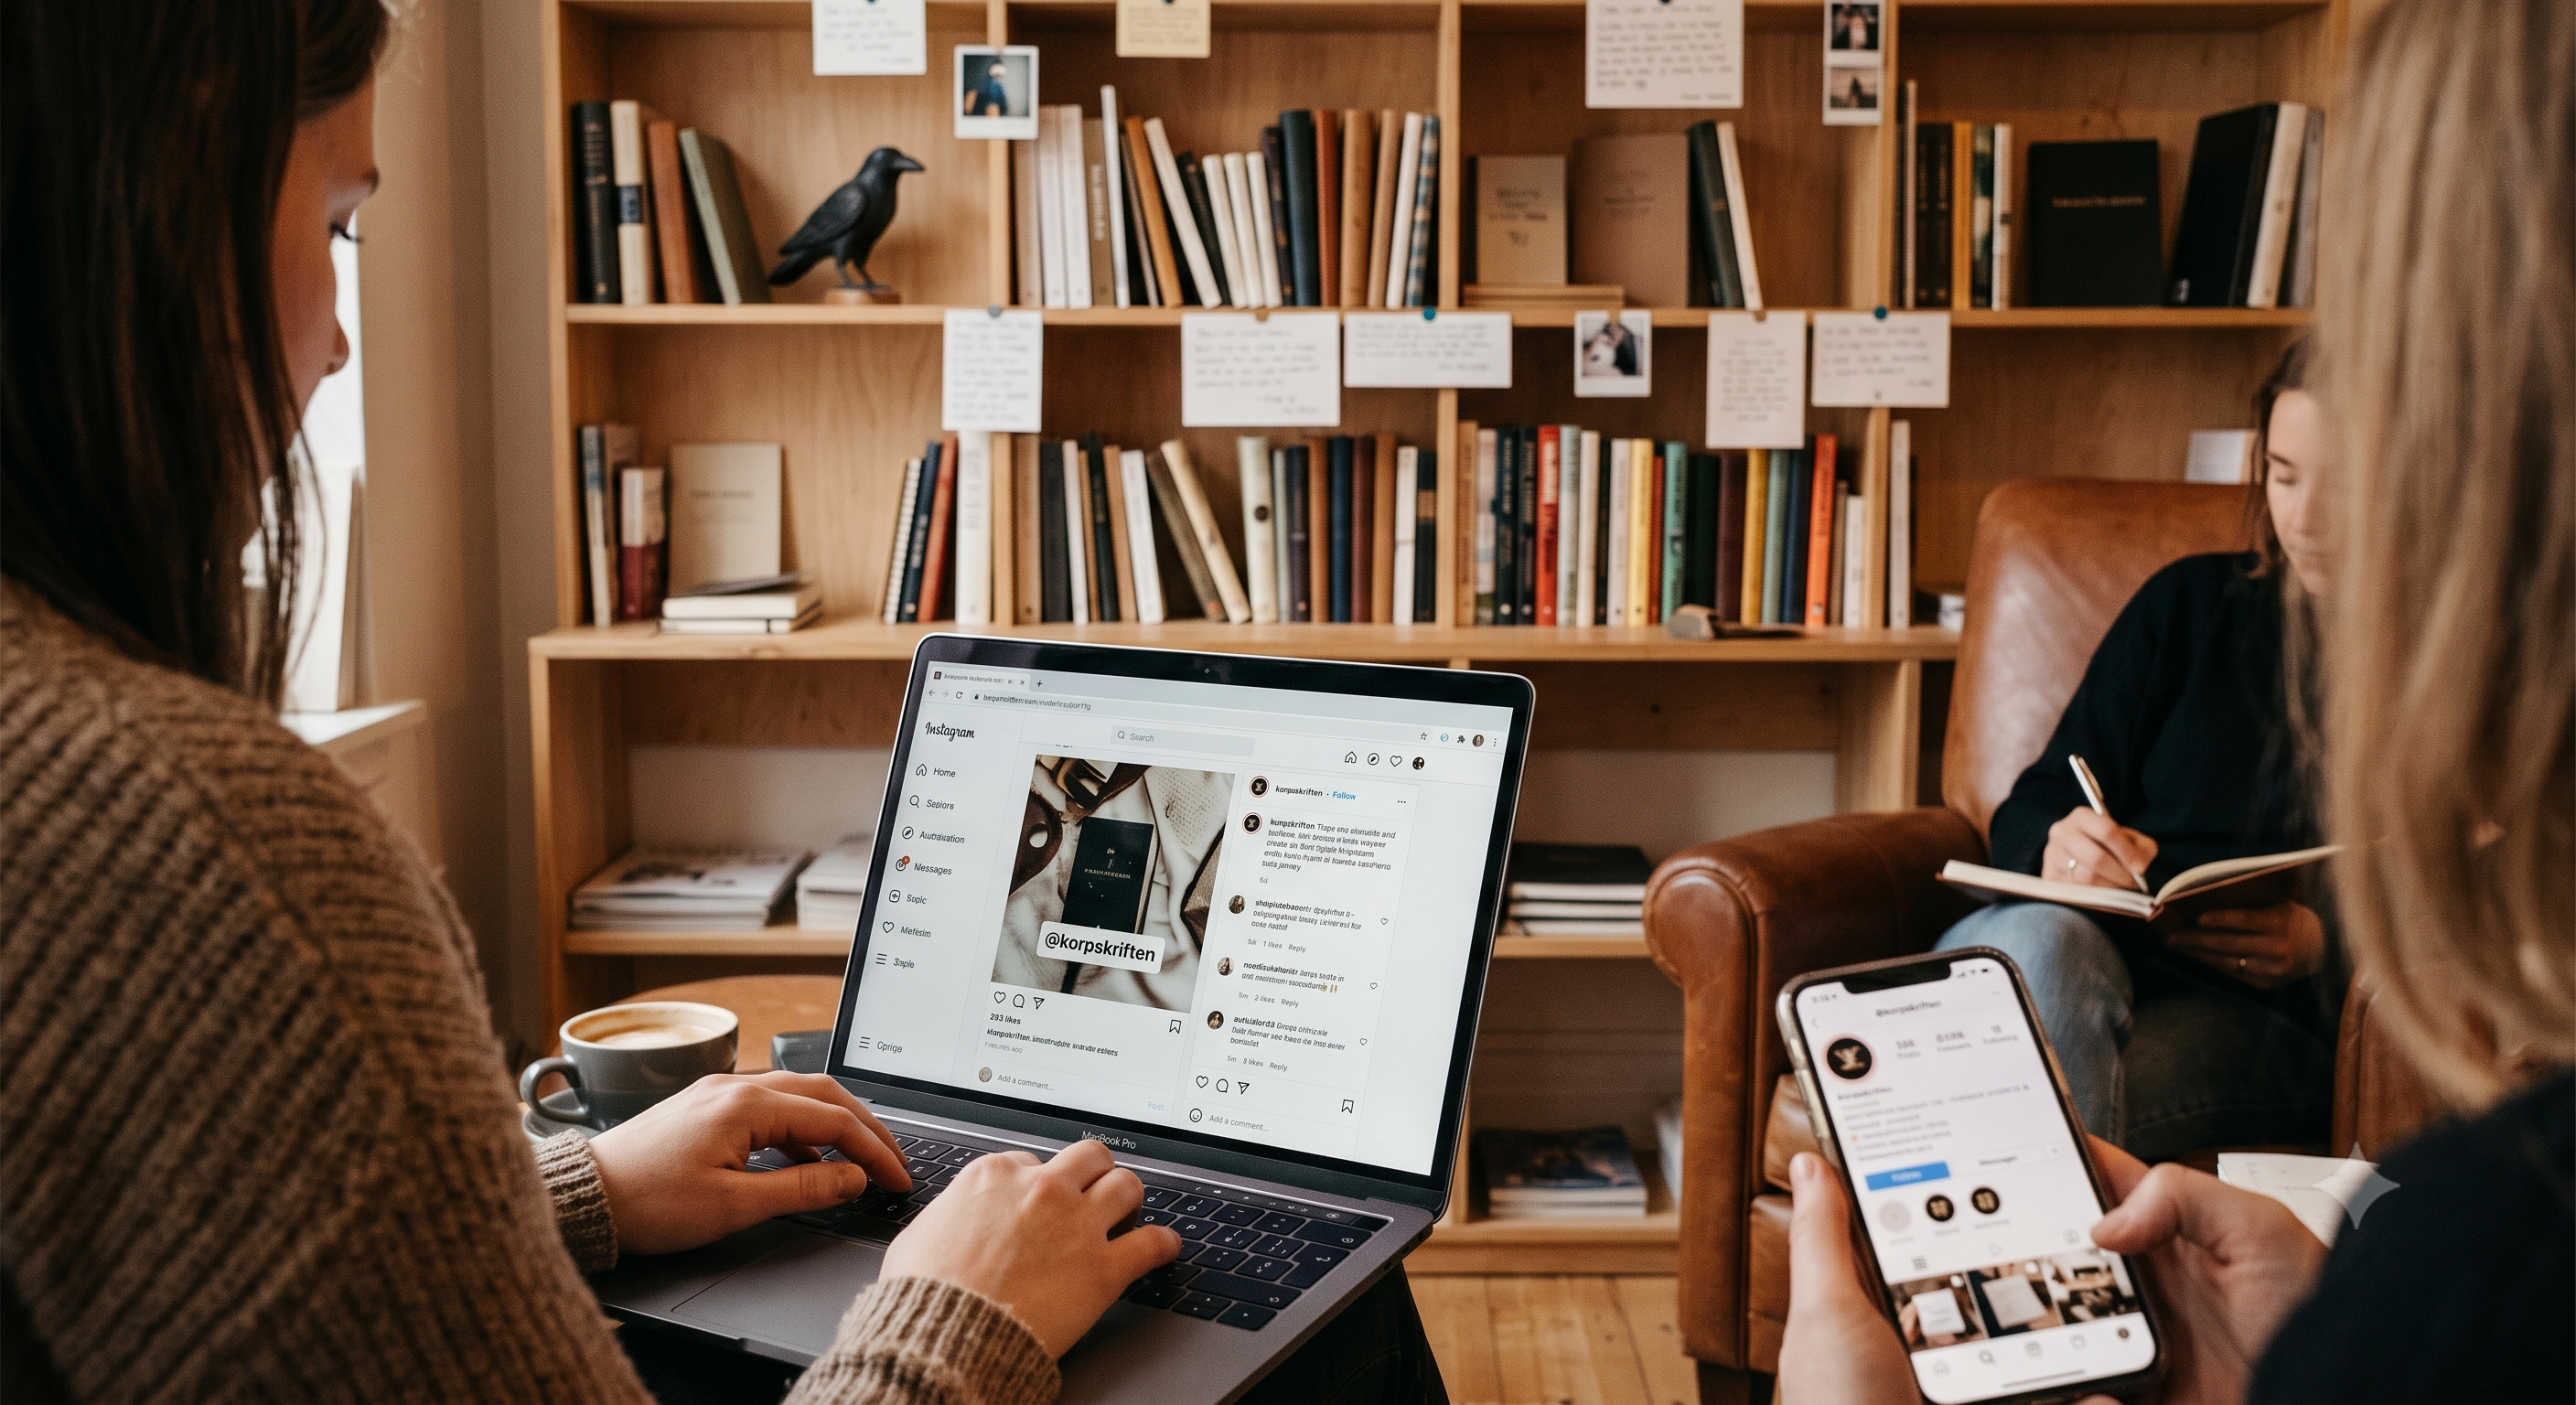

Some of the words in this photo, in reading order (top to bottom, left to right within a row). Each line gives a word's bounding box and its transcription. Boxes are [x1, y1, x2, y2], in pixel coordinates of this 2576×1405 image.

[925, 722, 976, 742] Instagram
[933, 767, 956, 778] Home
[1332, 791, 1357, 800] Follow
[1266, 840, 1288, 848] create
[1045, 931, 1156, 962] @korpskriften
[1288, 944, 1307, 953] Reply
[1281, 998, 1300, 1009] Reply
[1004, 1015, 1022, 1024] likes
[1269, 1062, 1289, 1072] Reply
[997, 1074, 1011, 1084] Add
[1017, 1078, 1055, 1091] comment...
[1147, 1100, 1165, 1111] Post
[1208, 1114, 1223, 1124] Add
[1229, 1119, 1270, 1132] comment...
[1122, 1138, 1137, 1150] Pro
